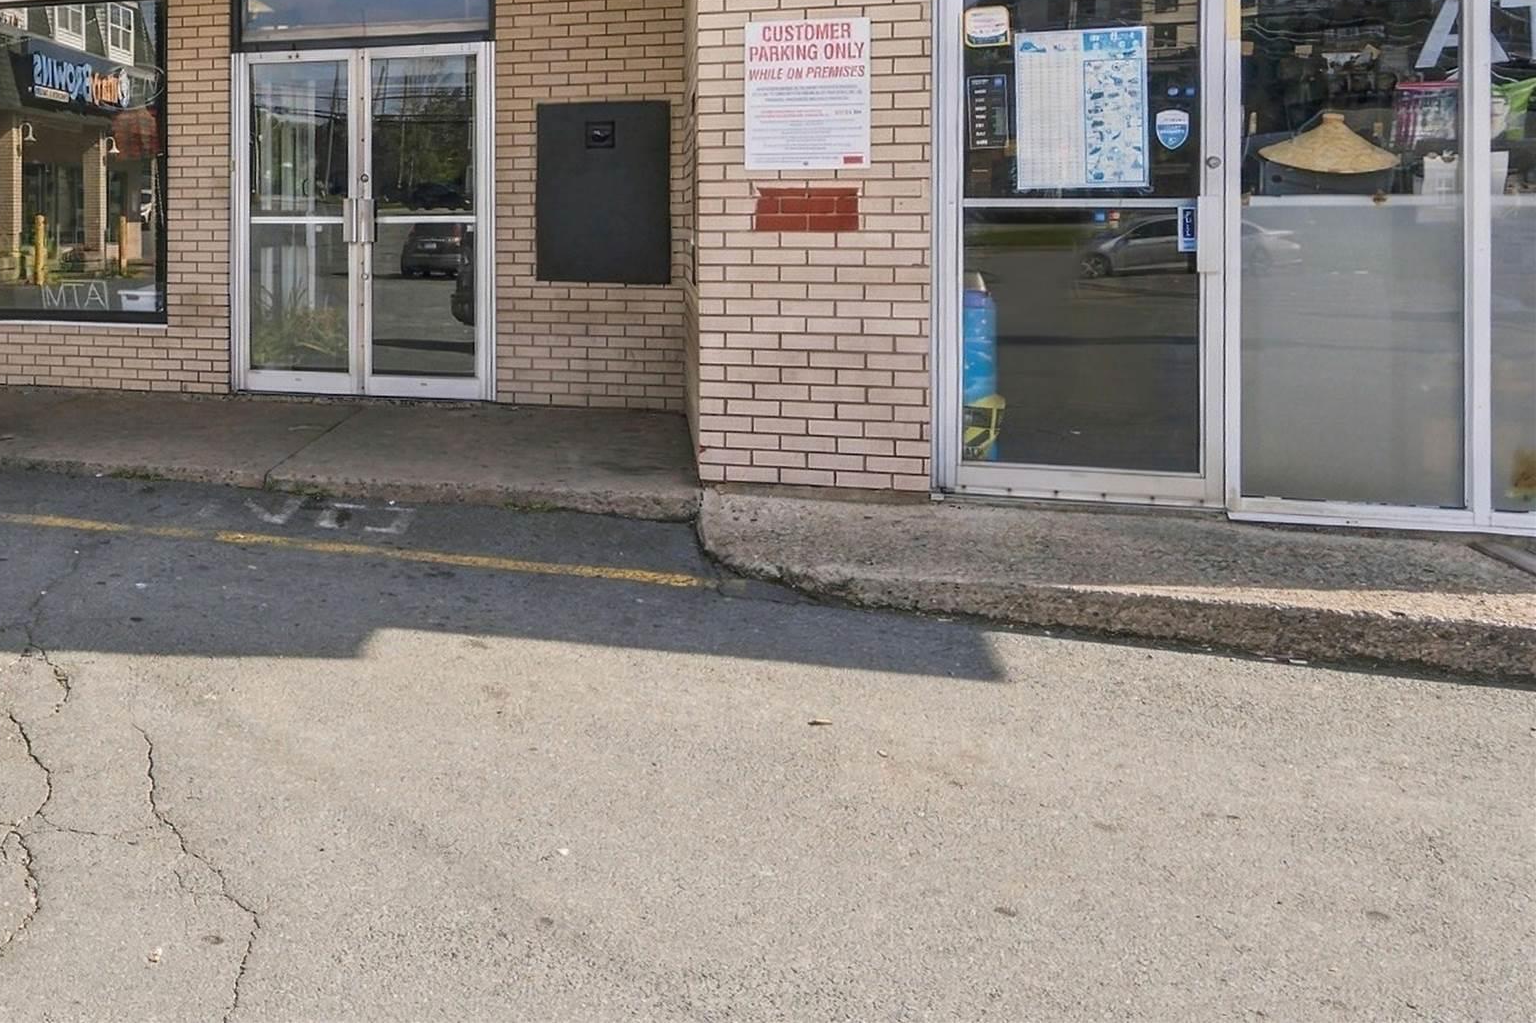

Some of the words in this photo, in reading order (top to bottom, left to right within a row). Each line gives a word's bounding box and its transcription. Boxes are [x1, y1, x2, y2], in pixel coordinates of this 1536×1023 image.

[762, 22, 851, 42] CUSTOMER
[749, 44, 818, 62] PARKING
[824, 42, 865, 60] ONLY
[749, 68, 783, 81] WHILE
[787, 67, 803, 79] ON
[806, 65, 866, 78] PREMISES
